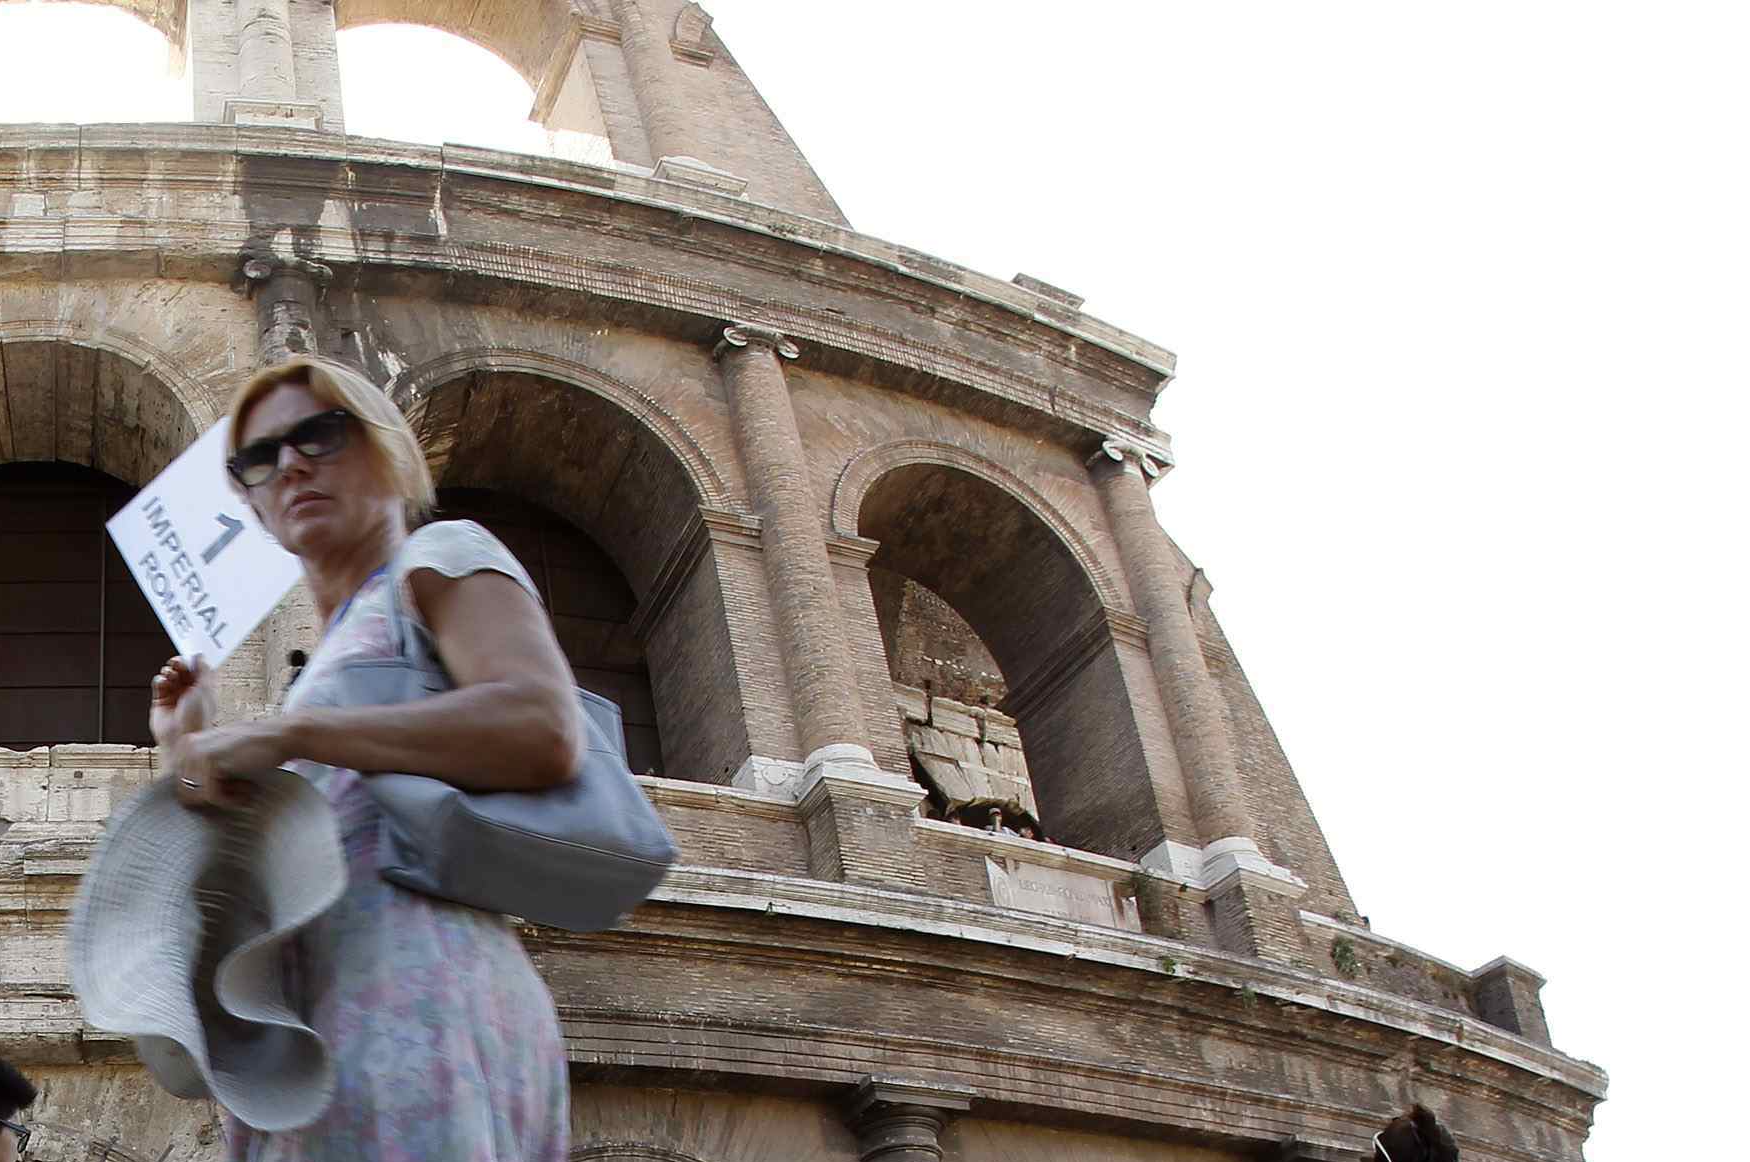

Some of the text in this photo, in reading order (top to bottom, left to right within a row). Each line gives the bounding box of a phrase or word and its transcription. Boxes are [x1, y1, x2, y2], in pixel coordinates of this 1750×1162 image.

[141, 496, 230, 649] IMPERIAL
[200, 512, 246, 566] 1
[138, 552, 194, 640] ROME
